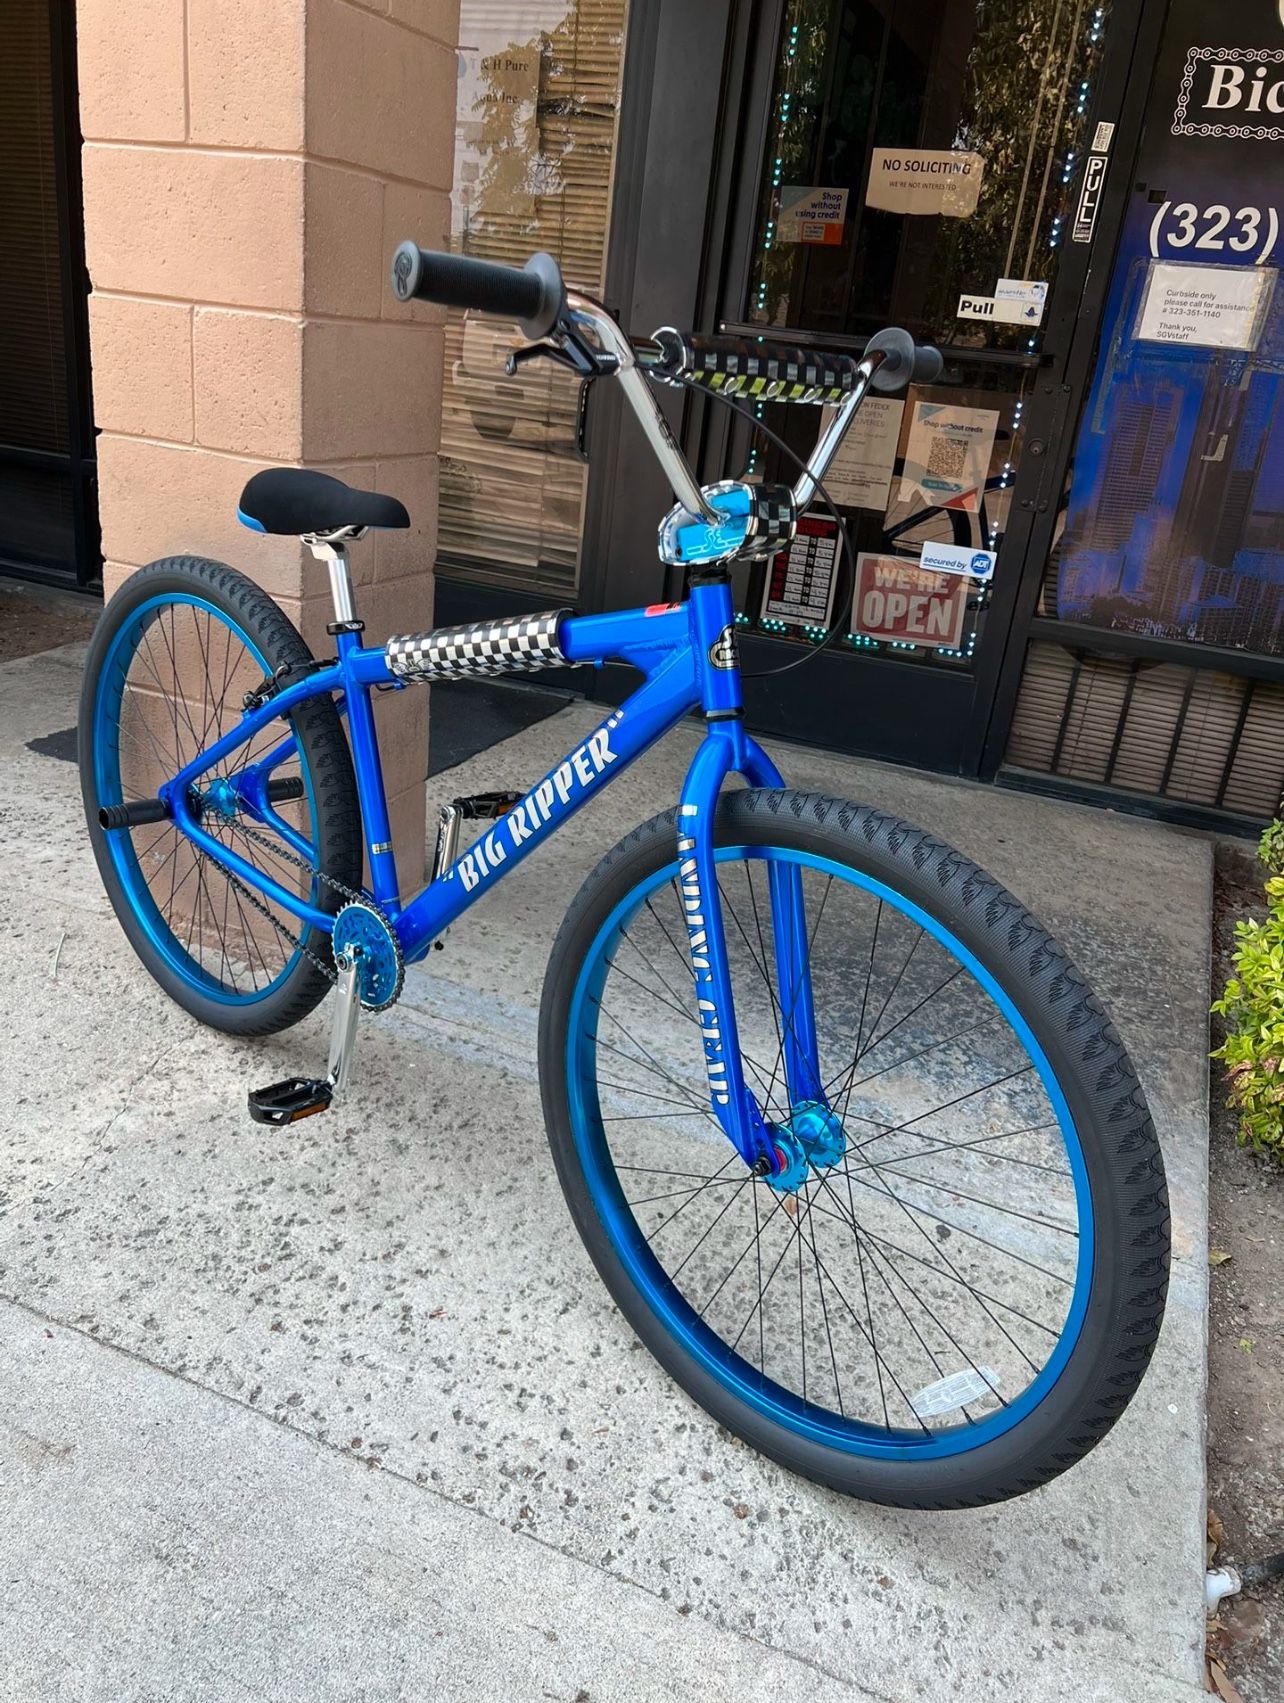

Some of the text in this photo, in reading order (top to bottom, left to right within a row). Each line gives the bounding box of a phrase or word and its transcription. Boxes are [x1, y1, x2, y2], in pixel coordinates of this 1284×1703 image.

[481, 59, 489, 70] &
[493, 59, 502, 71] H
[505, 59, 529, 72] Pure
[882, 159, 972, 175] NO SOLICITING
[908, 182, 921, 190] NOT
[922, 183, 957, 192] INTERESTED
[1079, 159, 1103, 223] PULL
[822, 192, 843, 202] Shop
[811, 202, 841, 210] without
[795, 209, 816, 219] using
[1150, 201, 1278, 265] (323)
[1166, 289, 1216, 300] Curbside only
[960, 300, 995, 315] Pull
[1163, 299, 1188, 307] please
[1203, 301, 1214, 309] for
[1168, 307, 1221, 318] 323-351-1140
[1159, 322, 1197, 333] Thank you,
[1156, 331, 1189, 340] SGVstaff
[923, 420, 939, 428] Shop
[964, 424, 983, 433] credit
[923, 556, 956, 567] secured
[973, 559, 989, 569] ADT
[874, 567, 949, 593] WE'RE
[862, 590, 953, 636] OPEN
